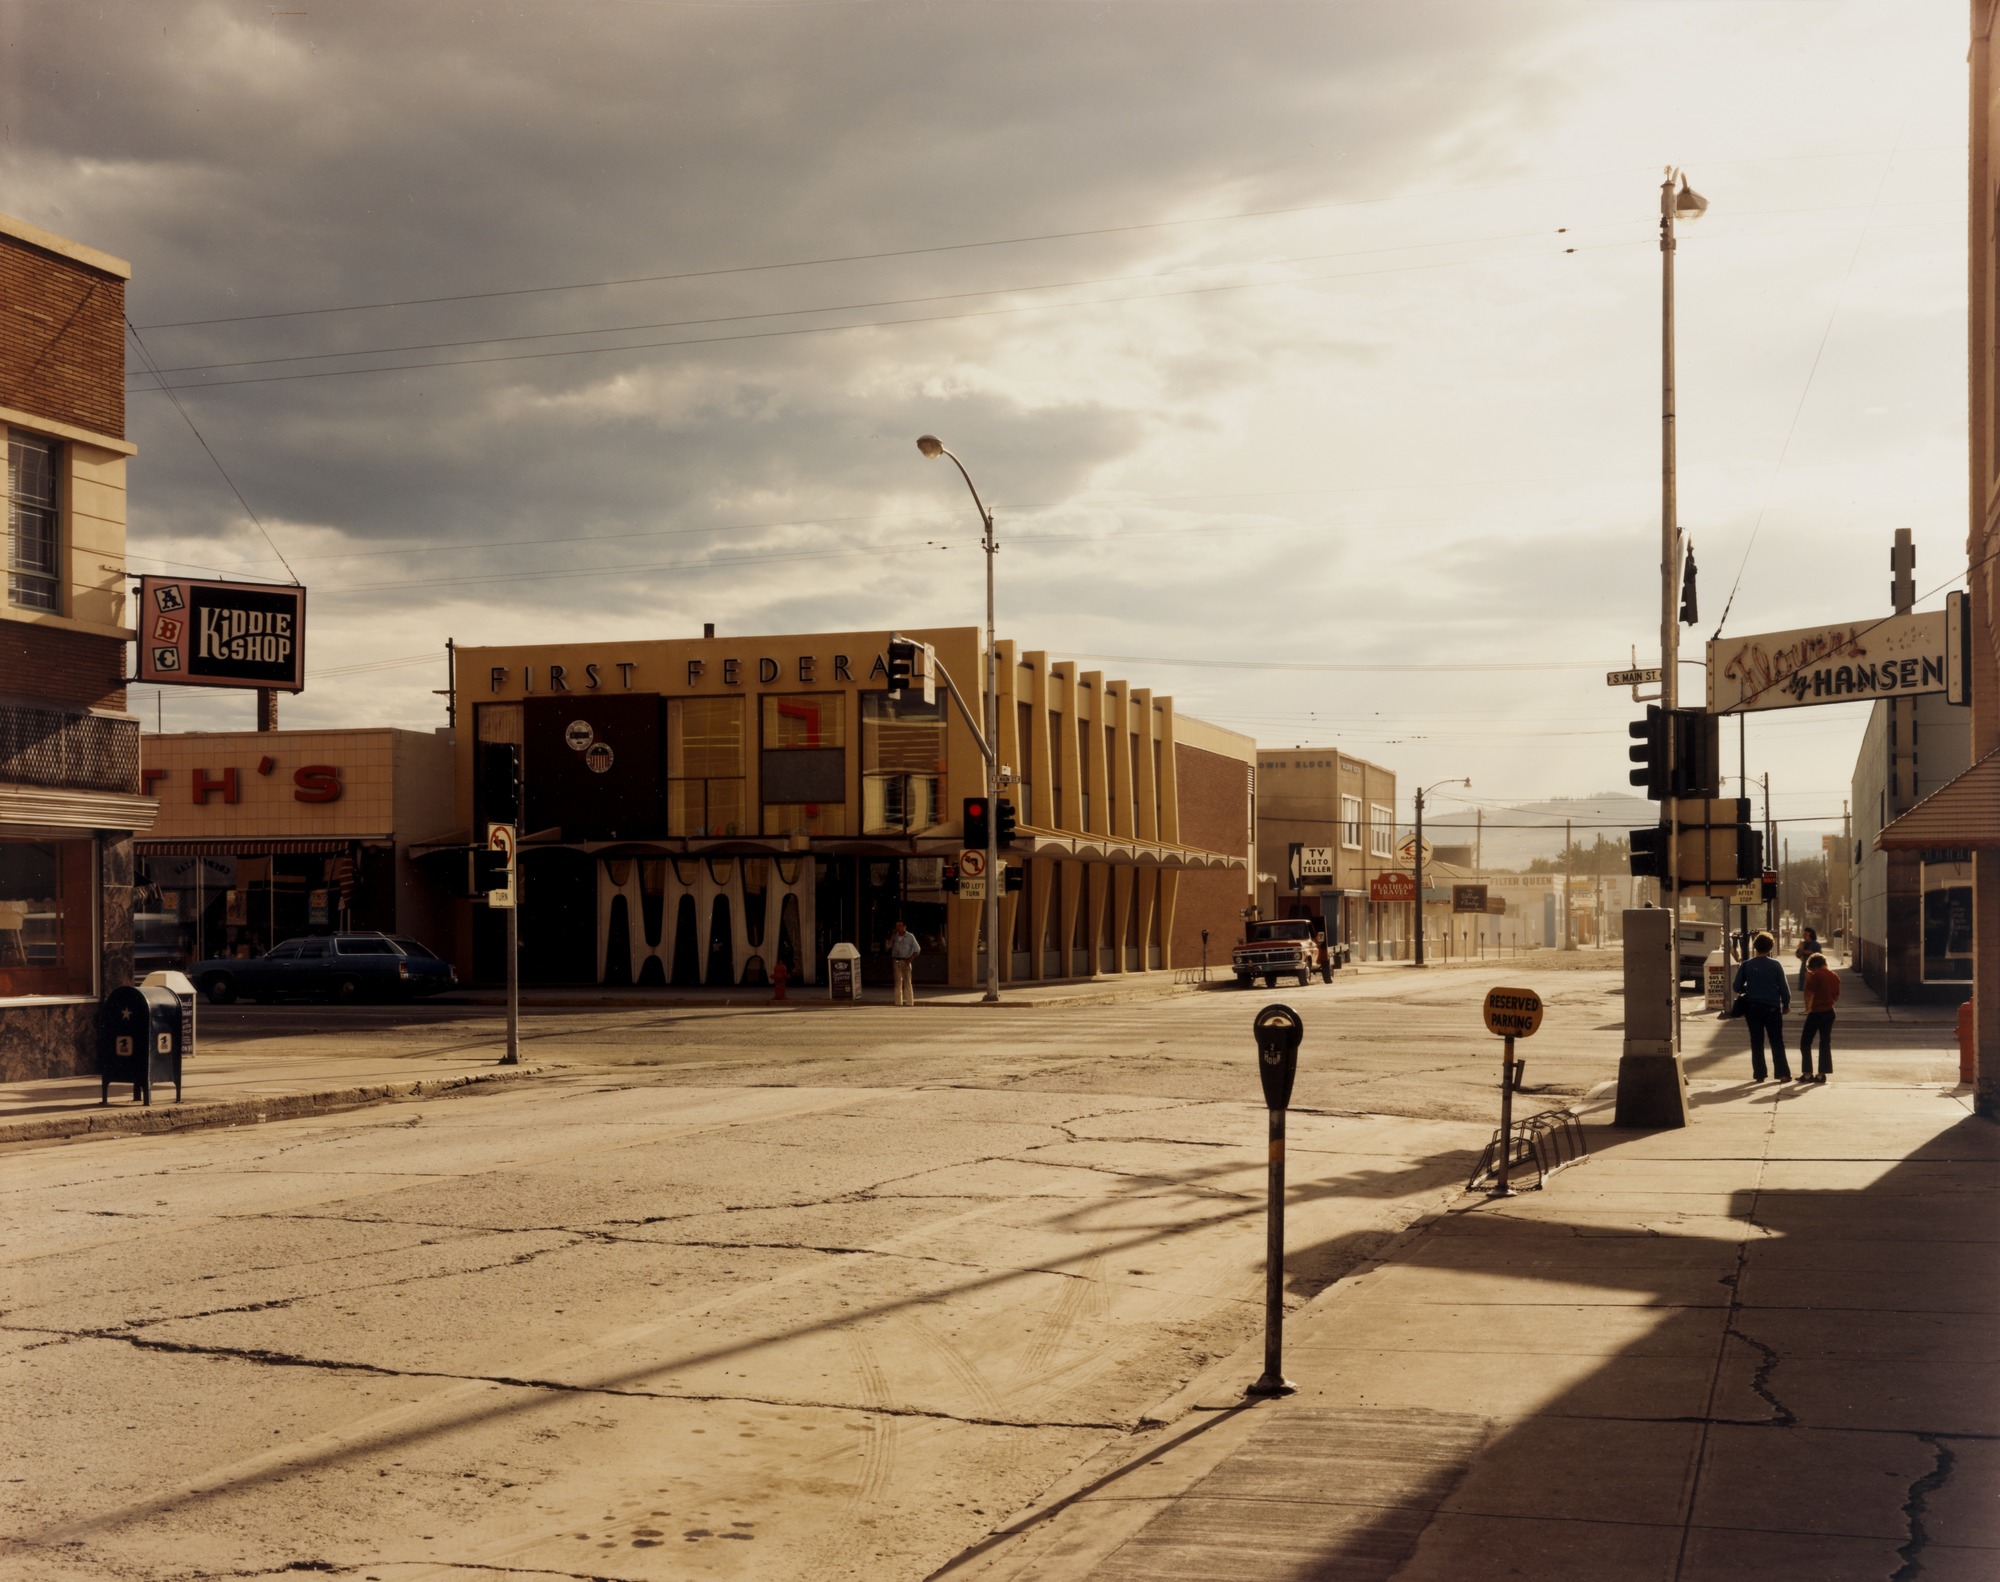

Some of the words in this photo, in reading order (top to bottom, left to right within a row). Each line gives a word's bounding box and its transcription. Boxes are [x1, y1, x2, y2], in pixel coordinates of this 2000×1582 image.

[160, 588, 181, 609] A
[158, 619, 177, 640] B
[231, 635, 291, 663] SHOP
[157, 649, 175, 668] C
[491, 661, 638, 693] FIRST
[1622, 672, 1642, 682] MAIN
[1814, 655, 1944, 697] HANSEN
[1295, 760, 1332, 769] BLOCK
[1309, 849, 1325, 857] TV
[1490, 877, 1520, 886] FILTER
[1522, 876, 1552, 887] QUEEN
[1489, 994, 1539, 1011] RESERVED
[1491, 1013, 1533, 1030] PARKING
[1270, 1043, 1275, 1051] 2
[1263, 1053, 1282, 1066] HOUR
